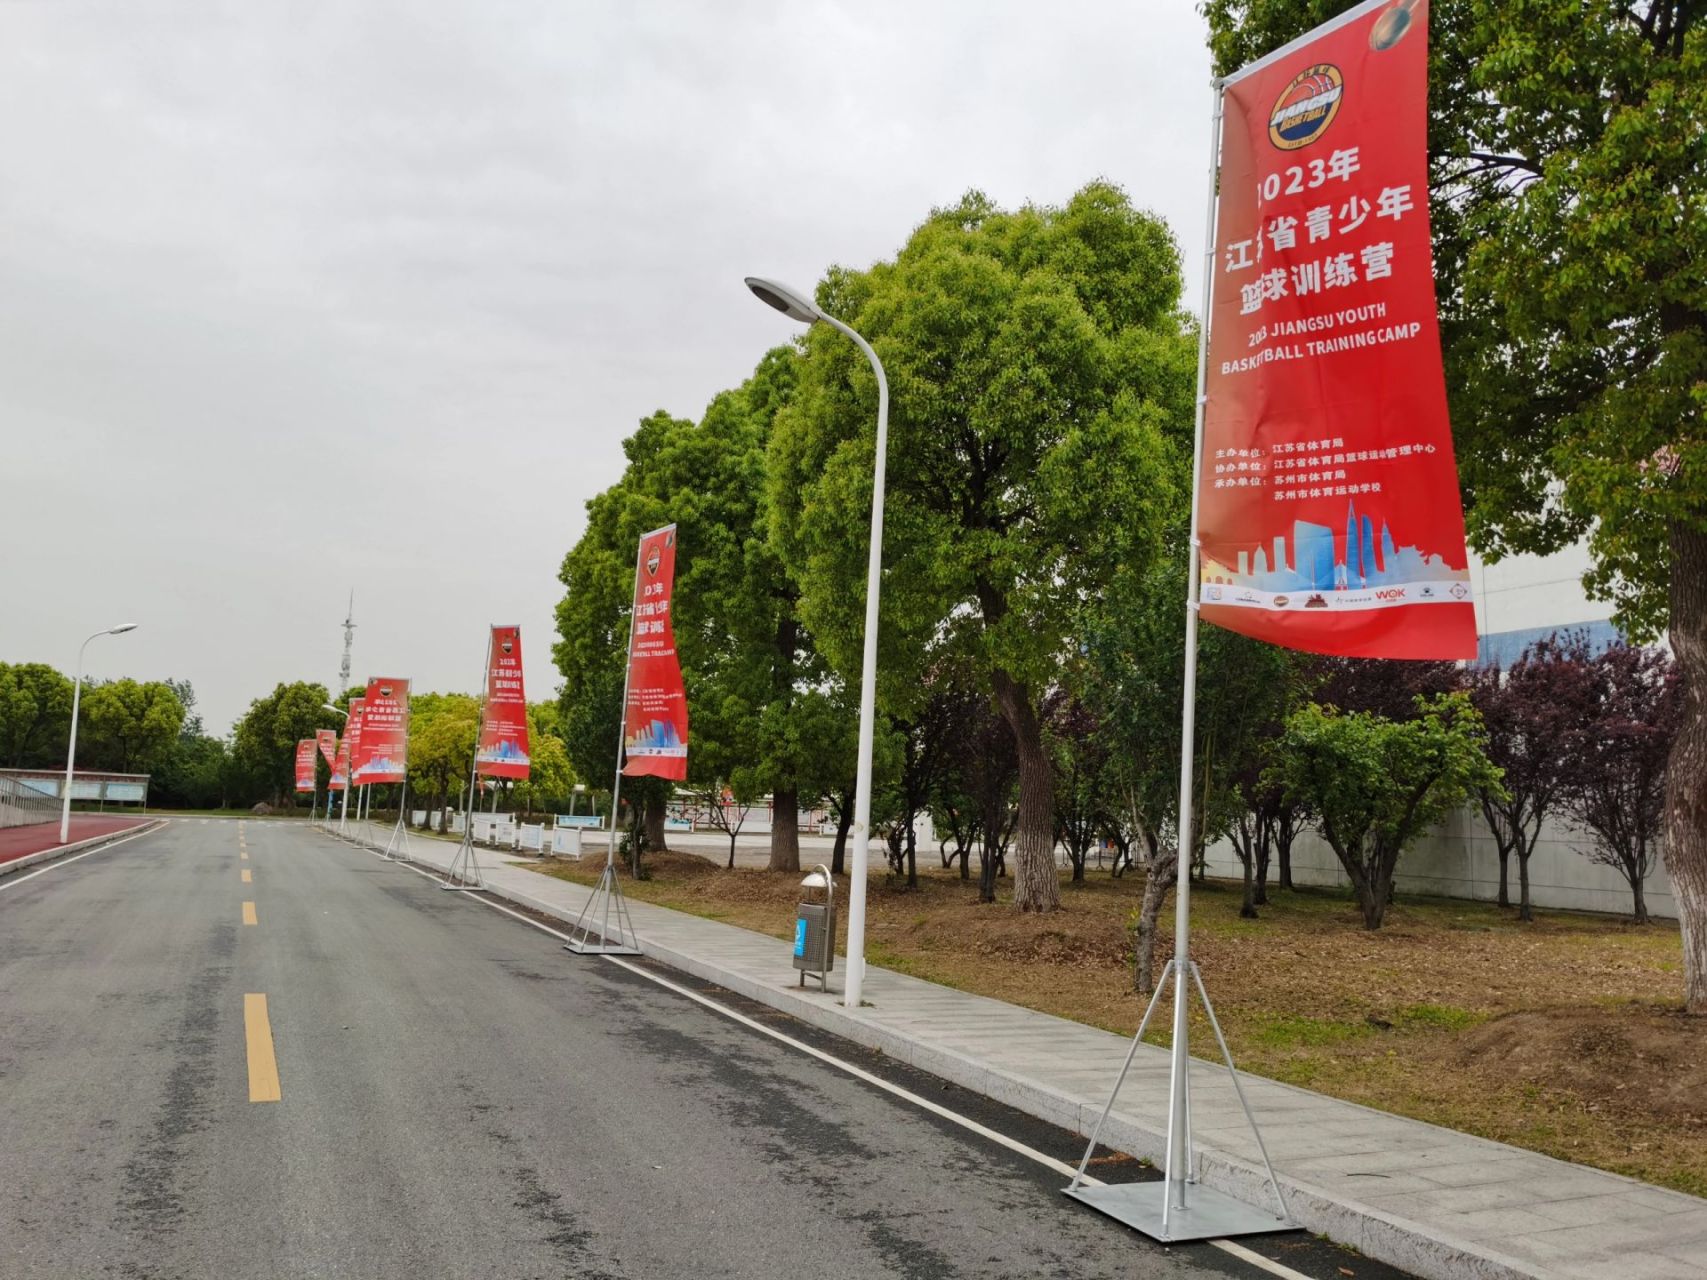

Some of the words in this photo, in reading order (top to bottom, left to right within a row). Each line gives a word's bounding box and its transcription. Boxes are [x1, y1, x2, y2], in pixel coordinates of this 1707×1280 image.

[1257, 146, 1361, 209] 023年
[1225, 185, 1414, 273] 江省青少年
[1240, 241, 1394, 315] 篮球训练营
[1271, 313, 1334, 337] JIANGSU
[1336, 302, 1387, 326] YOUTH
[1375, 587, 1406, 600] WOK
